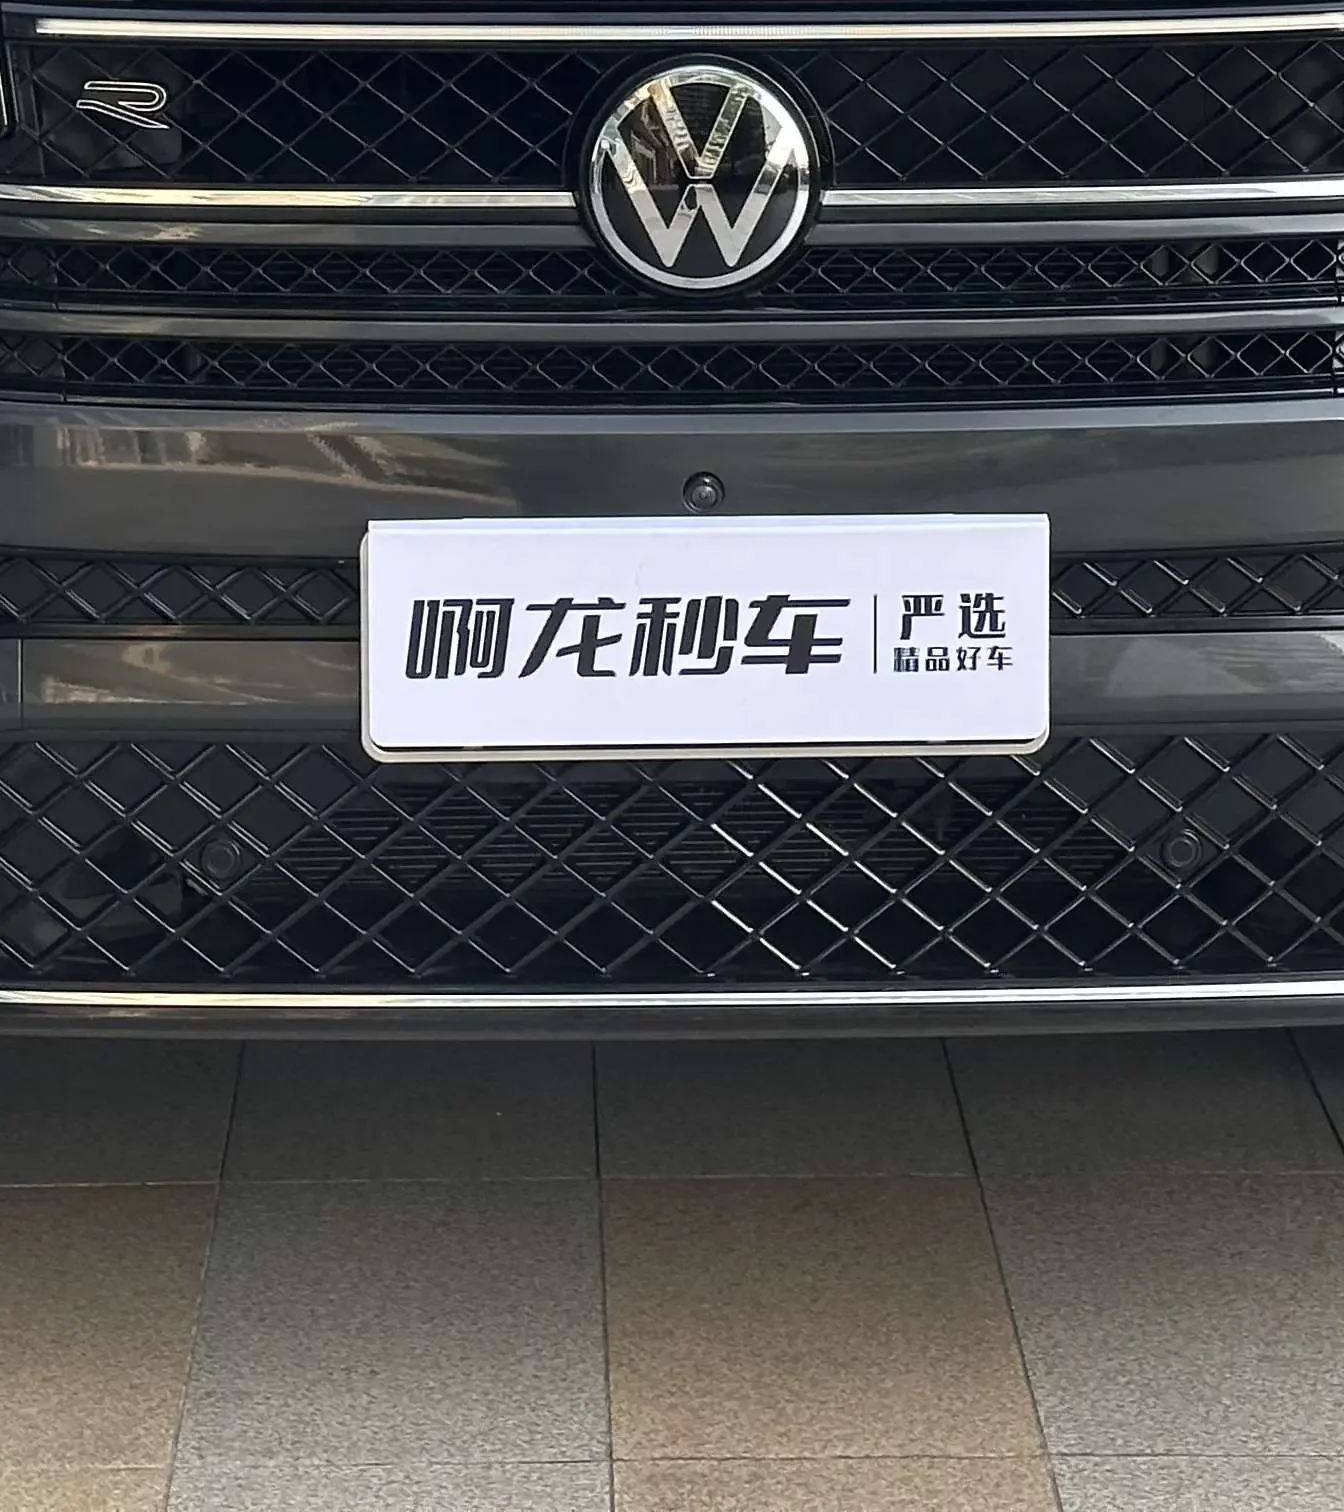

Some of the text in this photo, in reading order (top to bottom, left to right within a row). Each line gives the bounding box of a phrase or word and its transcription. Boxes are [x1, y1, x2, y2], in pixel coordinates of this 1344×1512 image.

[597, 74, 803, 270] VW
[404, 594, 851, 679] 啊龙秒车
[899, 592, 1006, 640] 严选
[893, 645, 1013, 673] 精品好车
